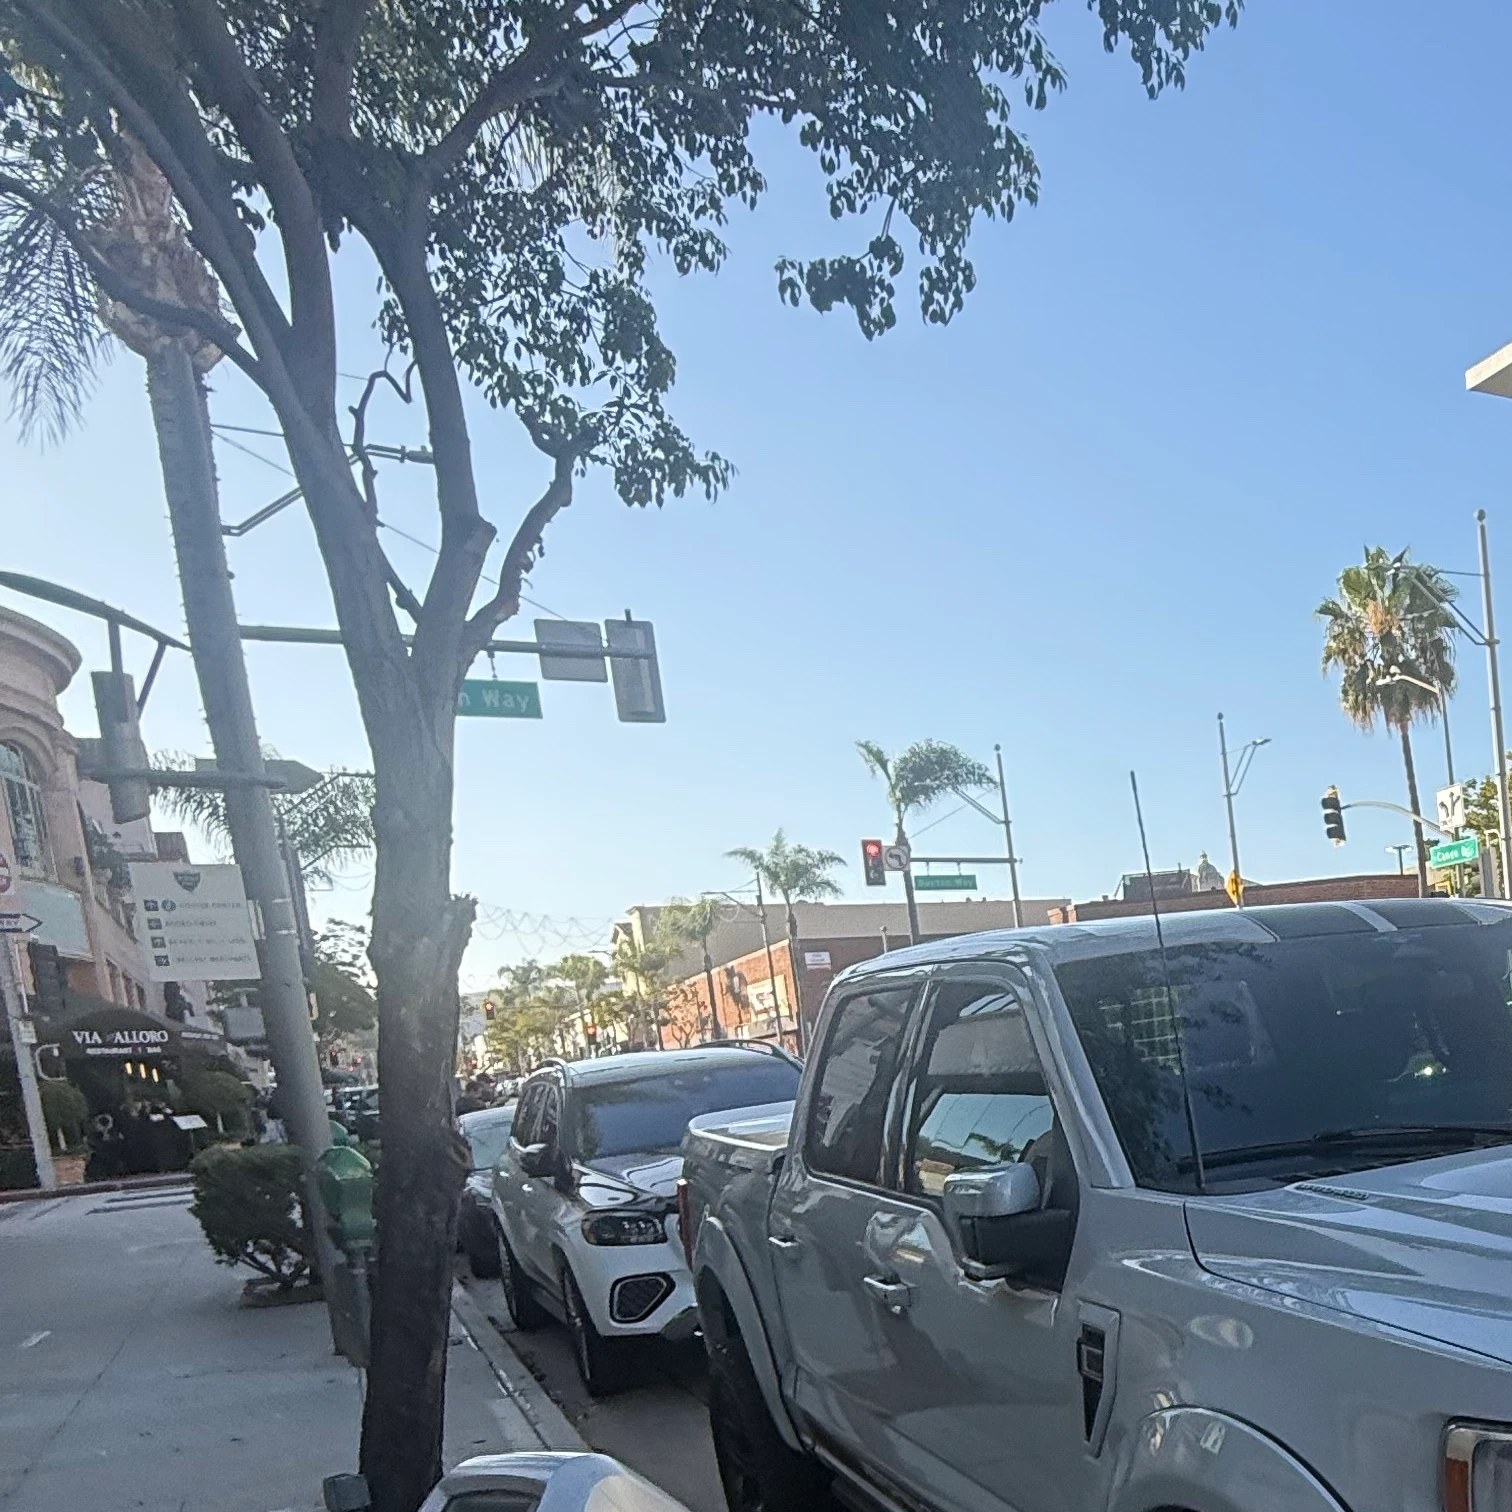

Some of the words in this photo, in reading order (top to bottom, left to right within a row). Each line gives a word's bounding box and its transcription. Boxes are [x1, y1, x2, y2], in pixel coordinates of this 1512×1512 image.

[481, 688, 529, 713] Way
[73, 1030, 102, 1044] VIA
[113, 1030, 169, 1044] ALLORO
